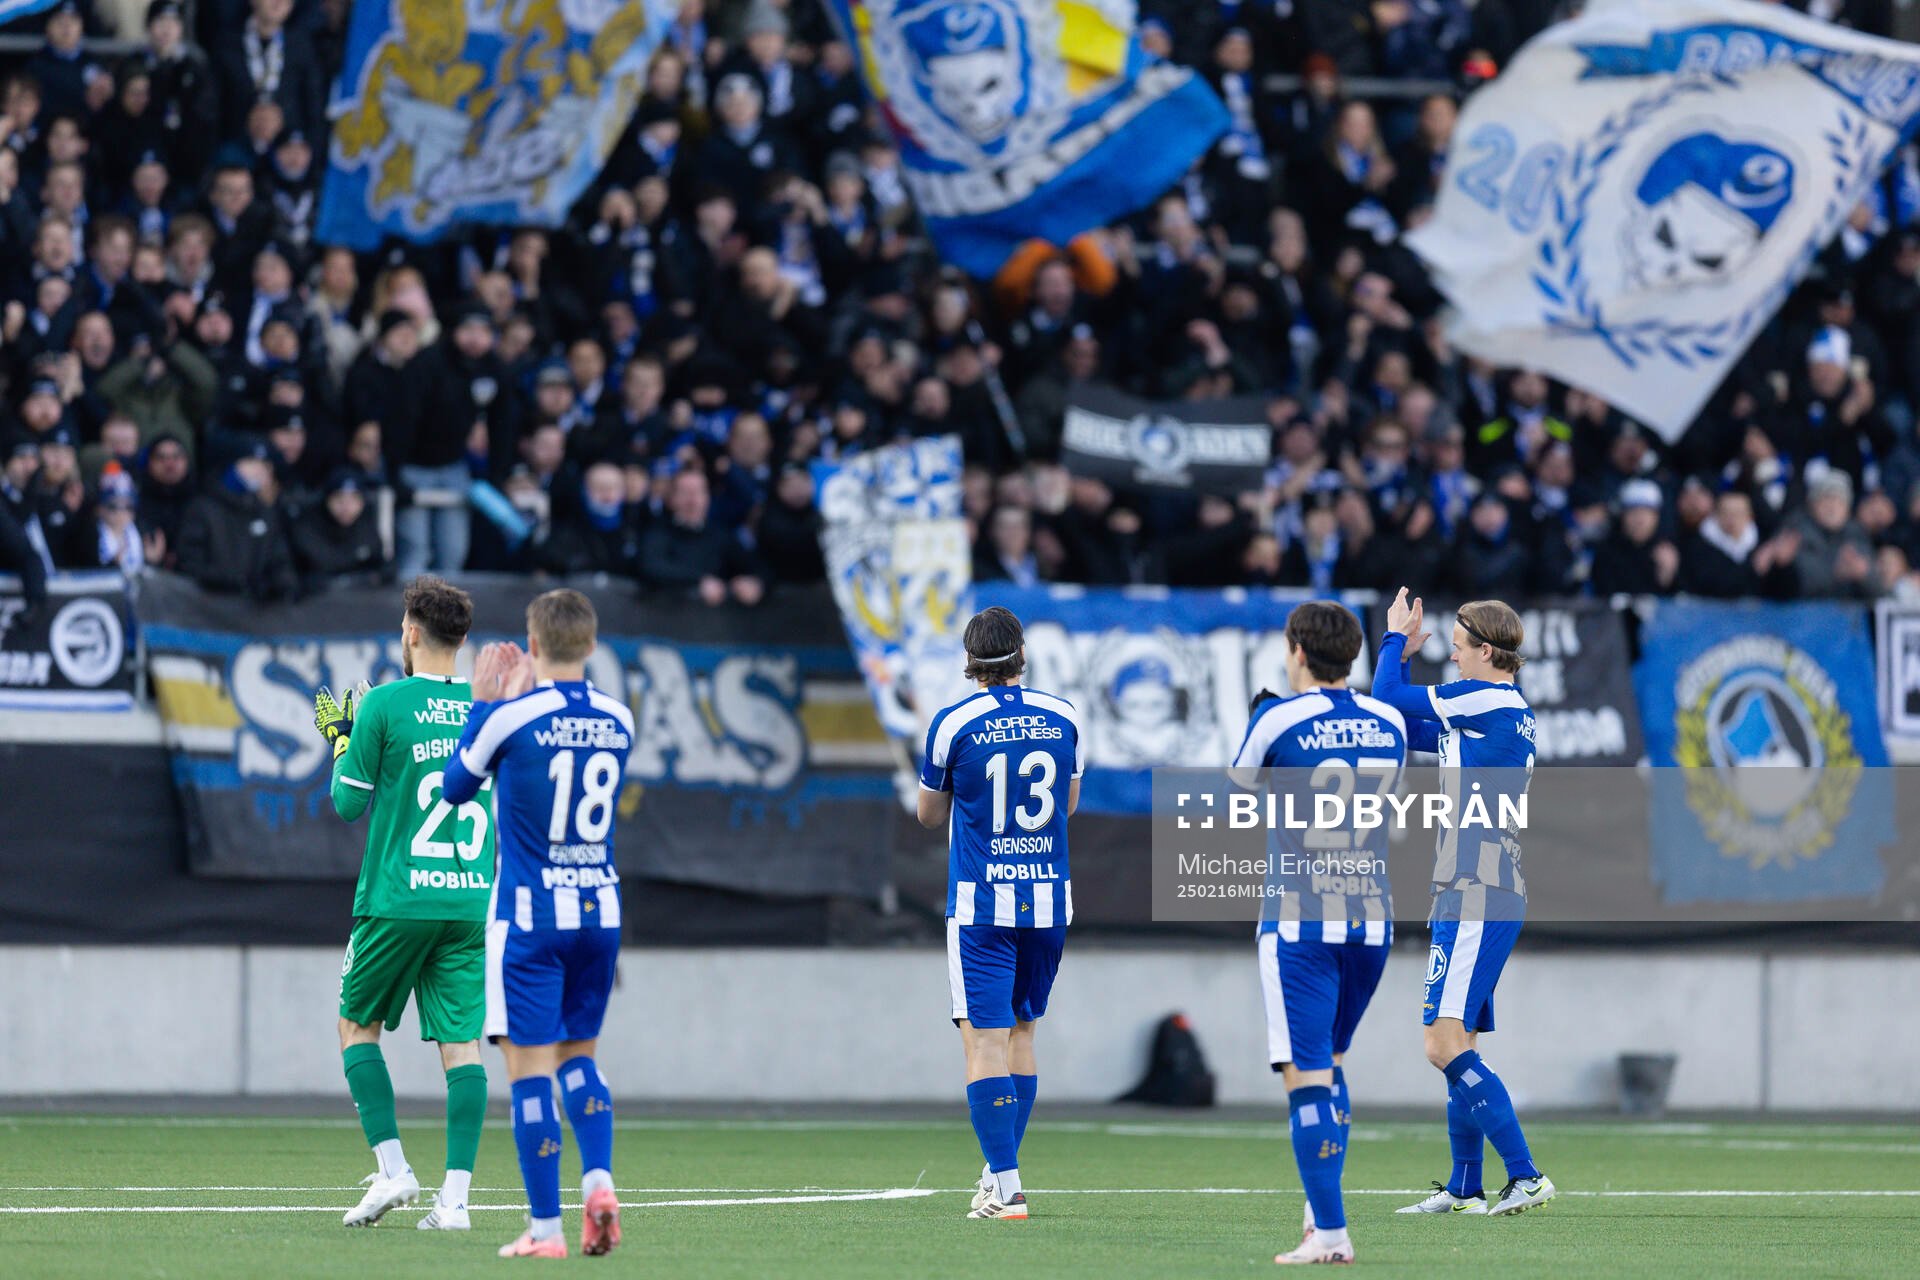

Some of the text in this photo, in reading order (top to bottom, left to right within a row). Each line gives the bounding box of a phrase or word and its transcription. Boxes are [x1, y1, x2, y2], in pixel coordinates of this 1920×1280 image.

[427, 697, 474, 714] NORD
[414, 710, 469, 727] WELLN
[985, 715, 1046, 731] NORDIC
[1312, 718, 1380, 735] NORDIC
[534, 730, 629, 749] WELLNESS
[972, 727, 1062, 745] WELLNESS
[1297, 732, 1396, 750] WELLNESS
[412, 738, 460, 763] BISH
[548, 749, 620, 844] 18
[985, 750, 1057, 834] 13
[1303, 757, 1399, 849] 27
[411, 770, 493, 862] 25
[990, 836, 1053, 856] SVENSSON
[410, 869, 490, 890] MOBILL
[986, 863, 1059, 882] MOBILL
